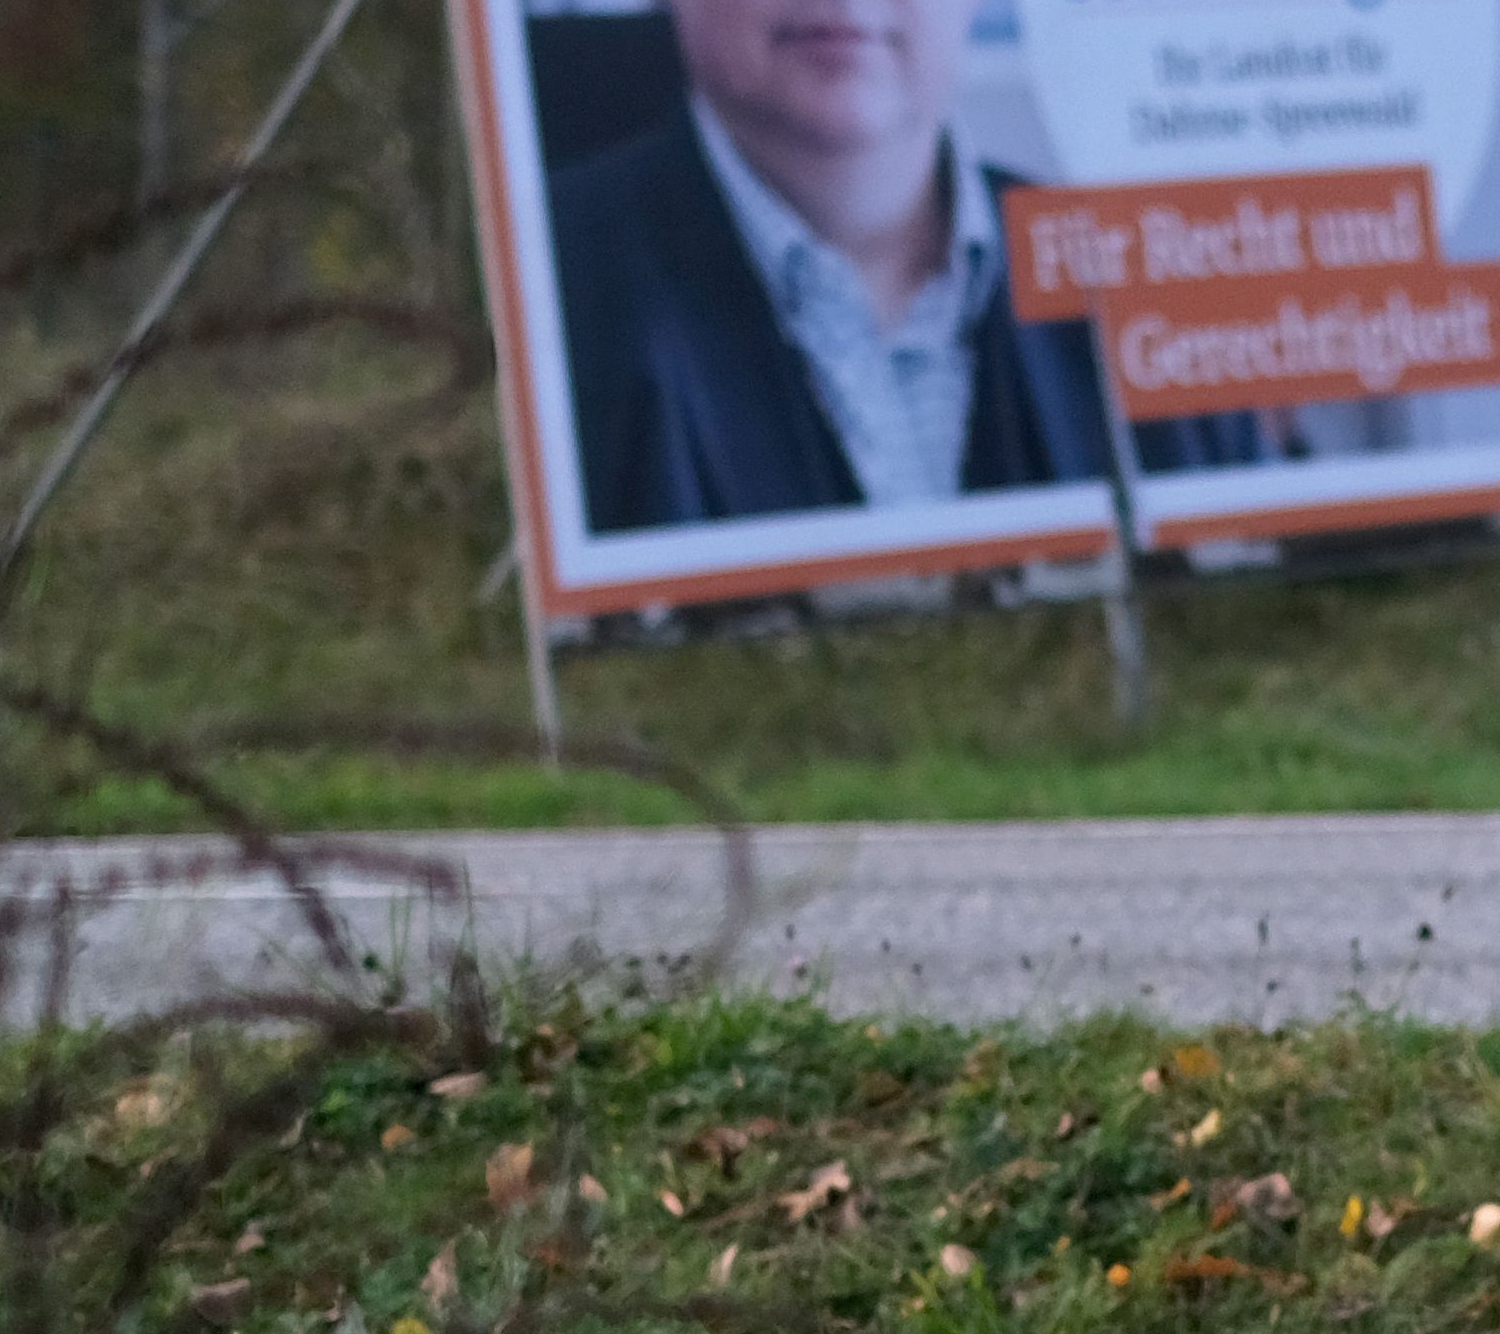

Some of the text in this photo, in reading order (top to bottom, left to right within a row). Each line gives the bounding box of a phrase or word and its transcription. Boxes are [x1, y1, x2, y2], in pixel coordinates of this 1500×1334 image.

[1029, 188, 1425, 291] Für Recht und
[1119, 285, 1494, 393] Gerechtigkeit
